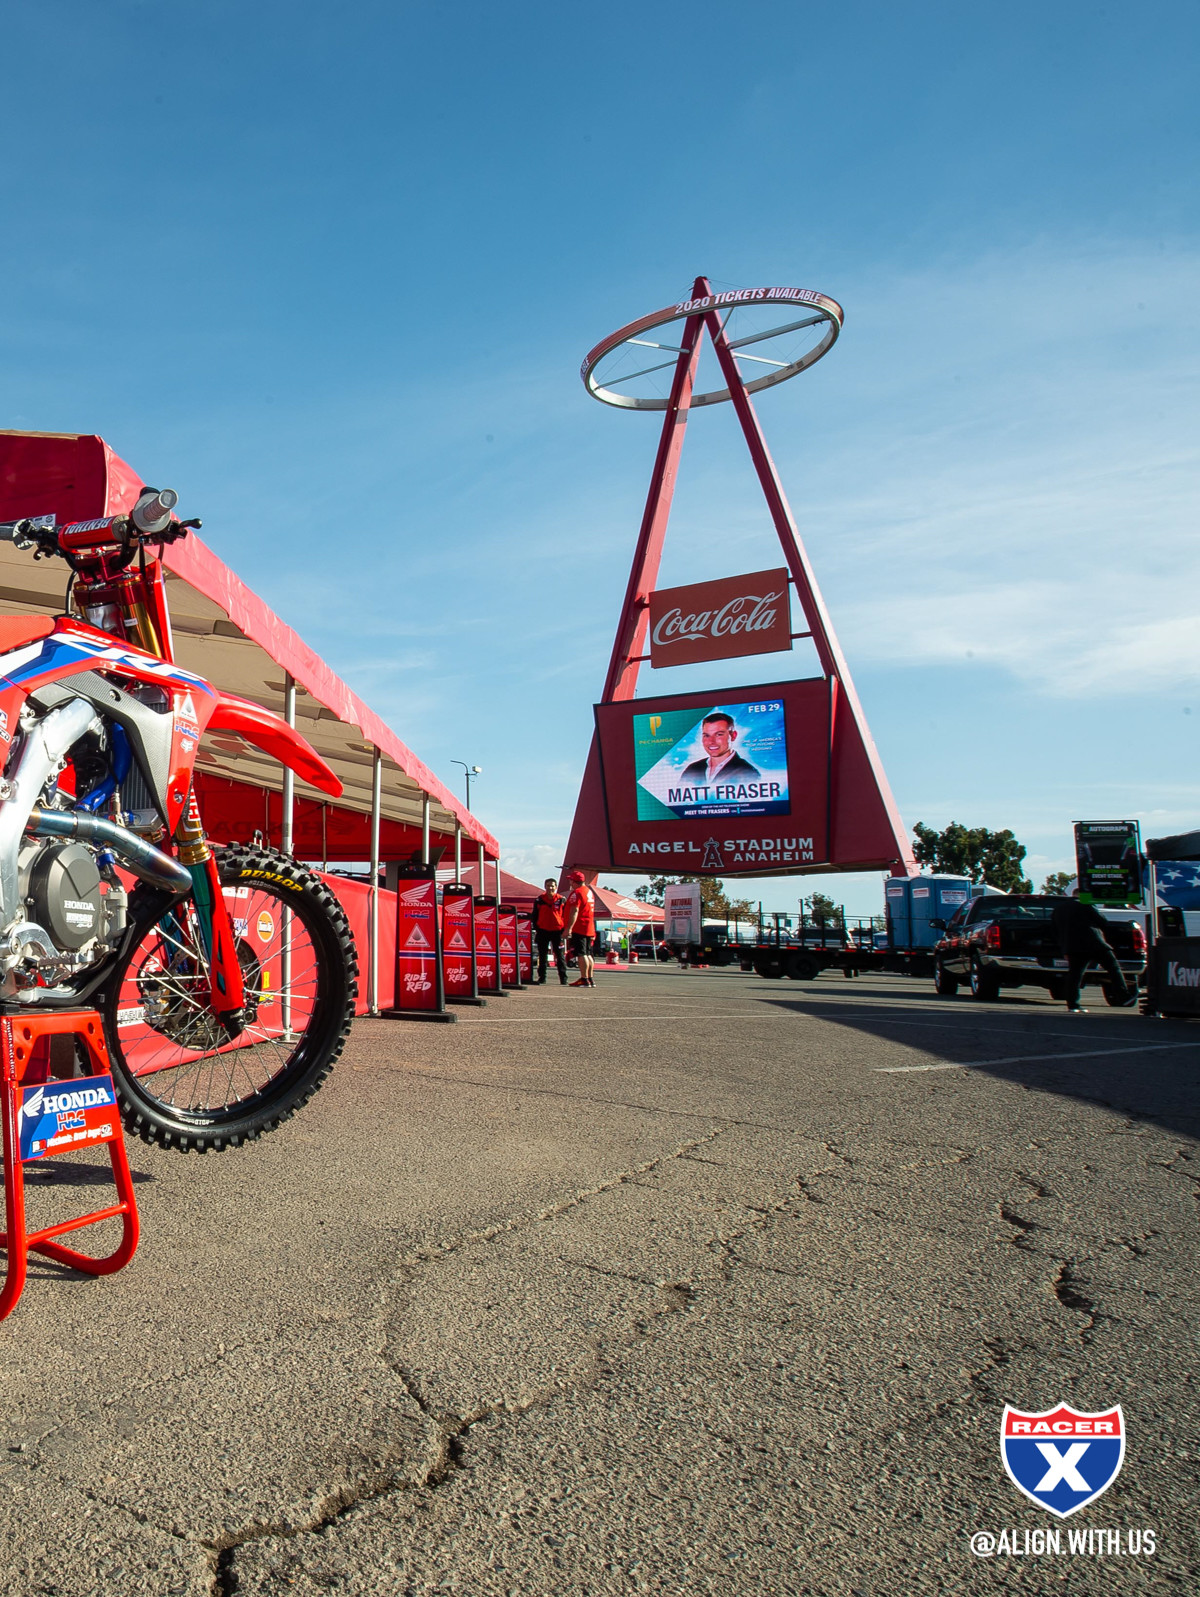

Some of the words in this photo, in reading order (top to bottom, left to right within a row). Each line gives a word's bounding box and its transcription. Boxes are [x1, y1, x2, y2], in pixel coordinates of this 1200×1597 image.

[674, 297, 710, 314] 2020
[714, 287, 766, 305] TICKETS
[766, 286, 821, 303] AVAILABLE
[64, 515, 113, 535] RENTHAL
[652, 590, 785, 646] Coca-Cola
[748, 705, 766, 713] FEB
[768, 703, 780, 711] 29
[668, 786, 710, 803] MATT
[716, 782, 781, 800] FRASER
[628, 839, 700, 854] ANGEL
[723, 837, 814, 851] STADIUM
[733, 851, 814, 862] ANAHEIM
[238, 869, 303, 892] DUNLOP
[64, 900, 96, 912] HONDA
[404, 972, 427, 982] RIDE
[446, 967, 465, 976] RIDE
[448, 974, 468, 983] RED
[406, 980, 432, 993] RED
[43, 1087, 111, 1115] HONDA
[56, 1109, 87, 1132] HRC
